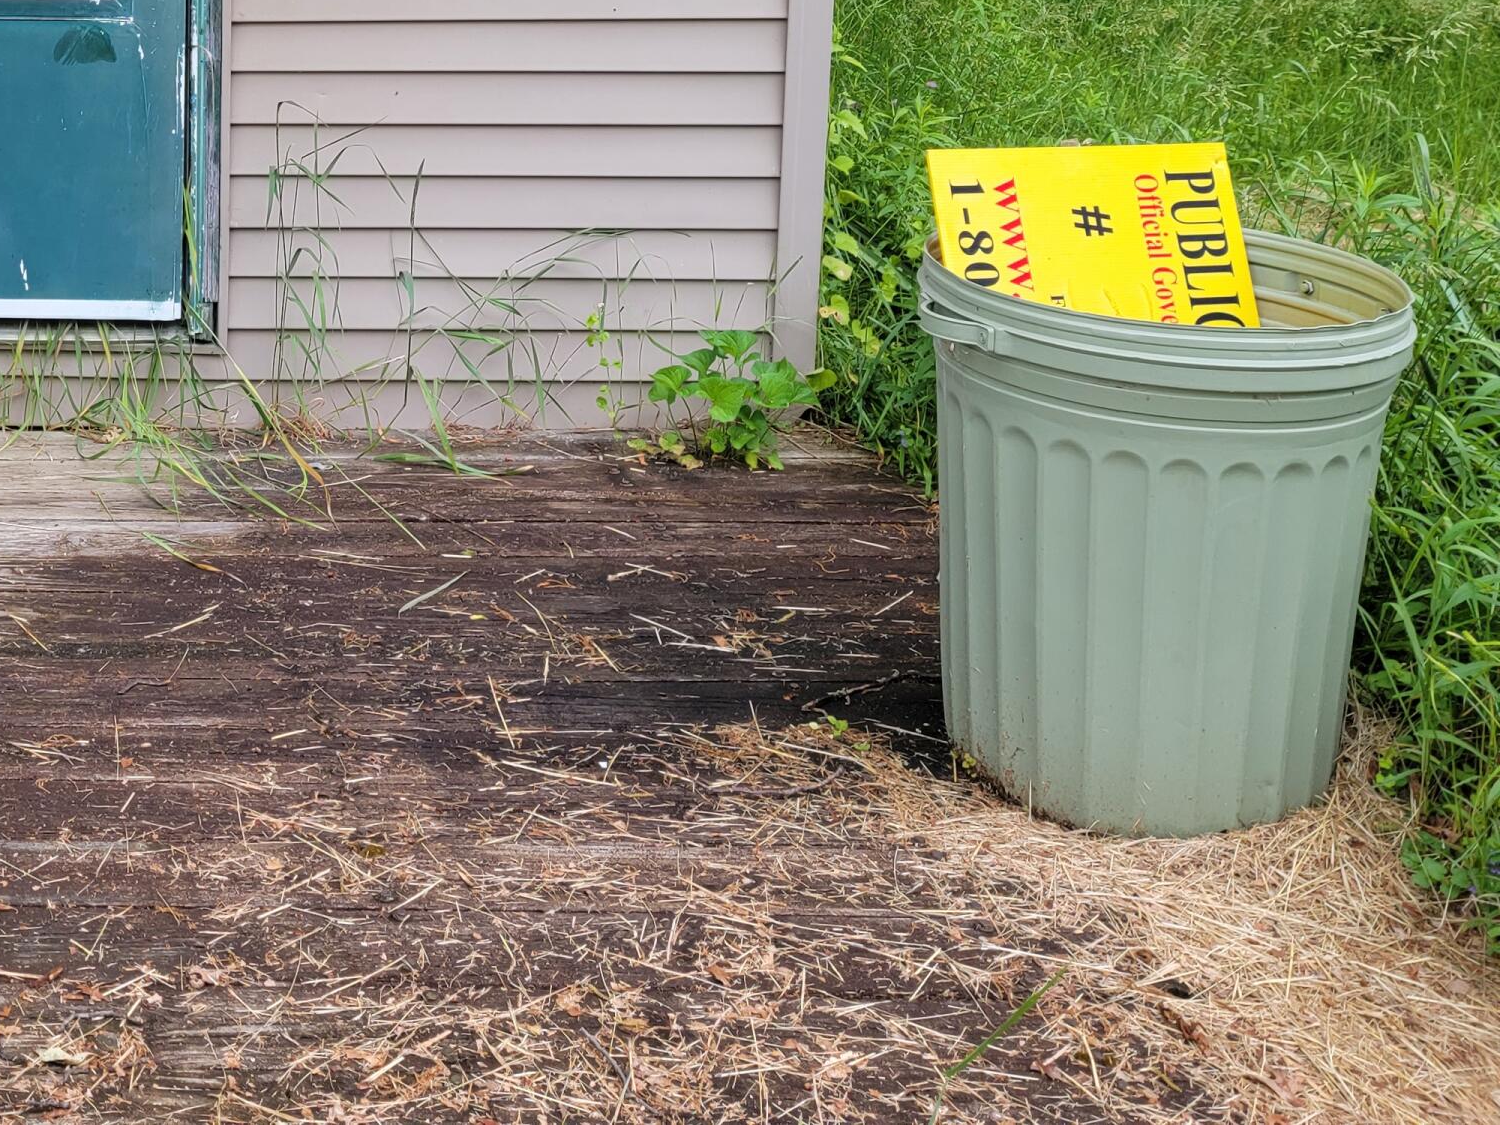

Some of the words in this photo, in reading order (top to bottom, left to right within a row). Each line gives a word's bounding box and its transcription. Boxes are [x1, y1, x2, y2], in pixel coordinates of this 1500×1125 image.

[949, 179, 999, 287] 1-80
[1071, 206, 1113, 237] #
[1134, 174, 1172, 259] Official
